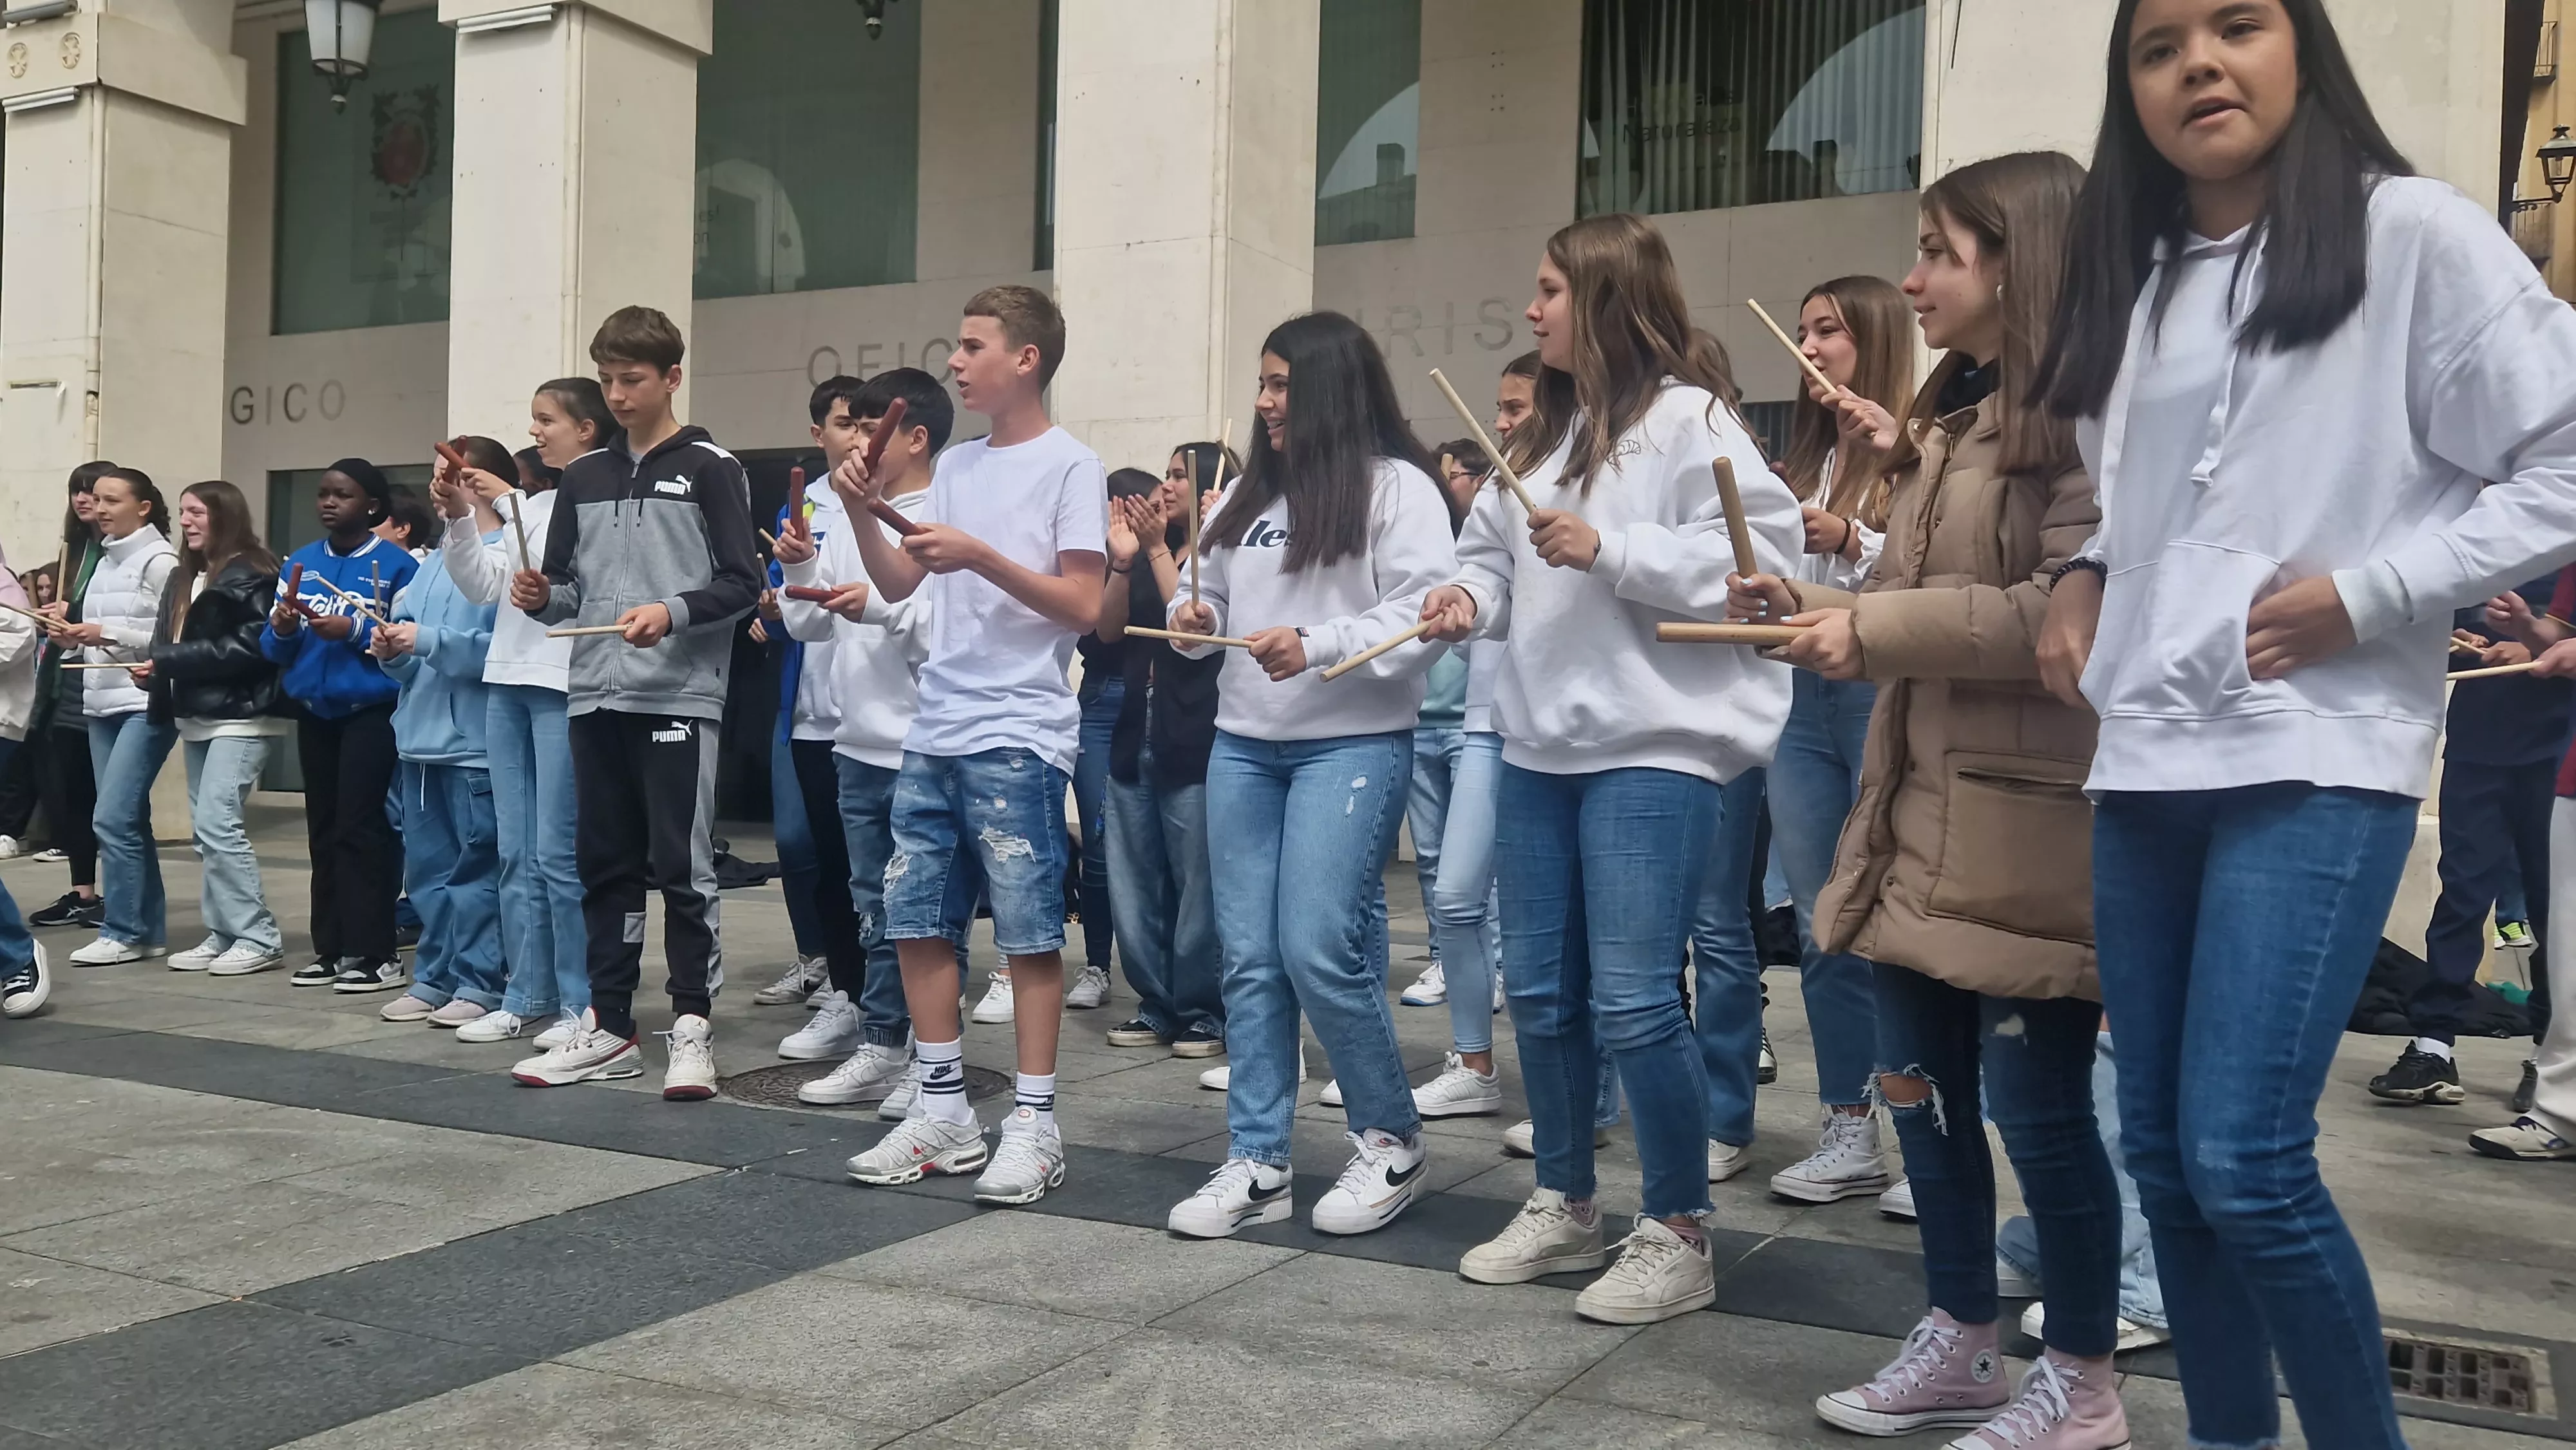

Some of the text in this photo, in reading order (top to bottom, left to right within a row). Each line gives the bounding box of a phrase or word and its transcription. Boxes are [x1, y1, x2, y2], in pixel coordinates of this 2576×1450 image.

[230, 379, 346, 426] GICO
[654, 480, 686, 495] PUMA
[1238, 520, 1289, 547] le
[652, 730, 687, 742] PUMA
[934, 1064, 952, 1075] NIKE
